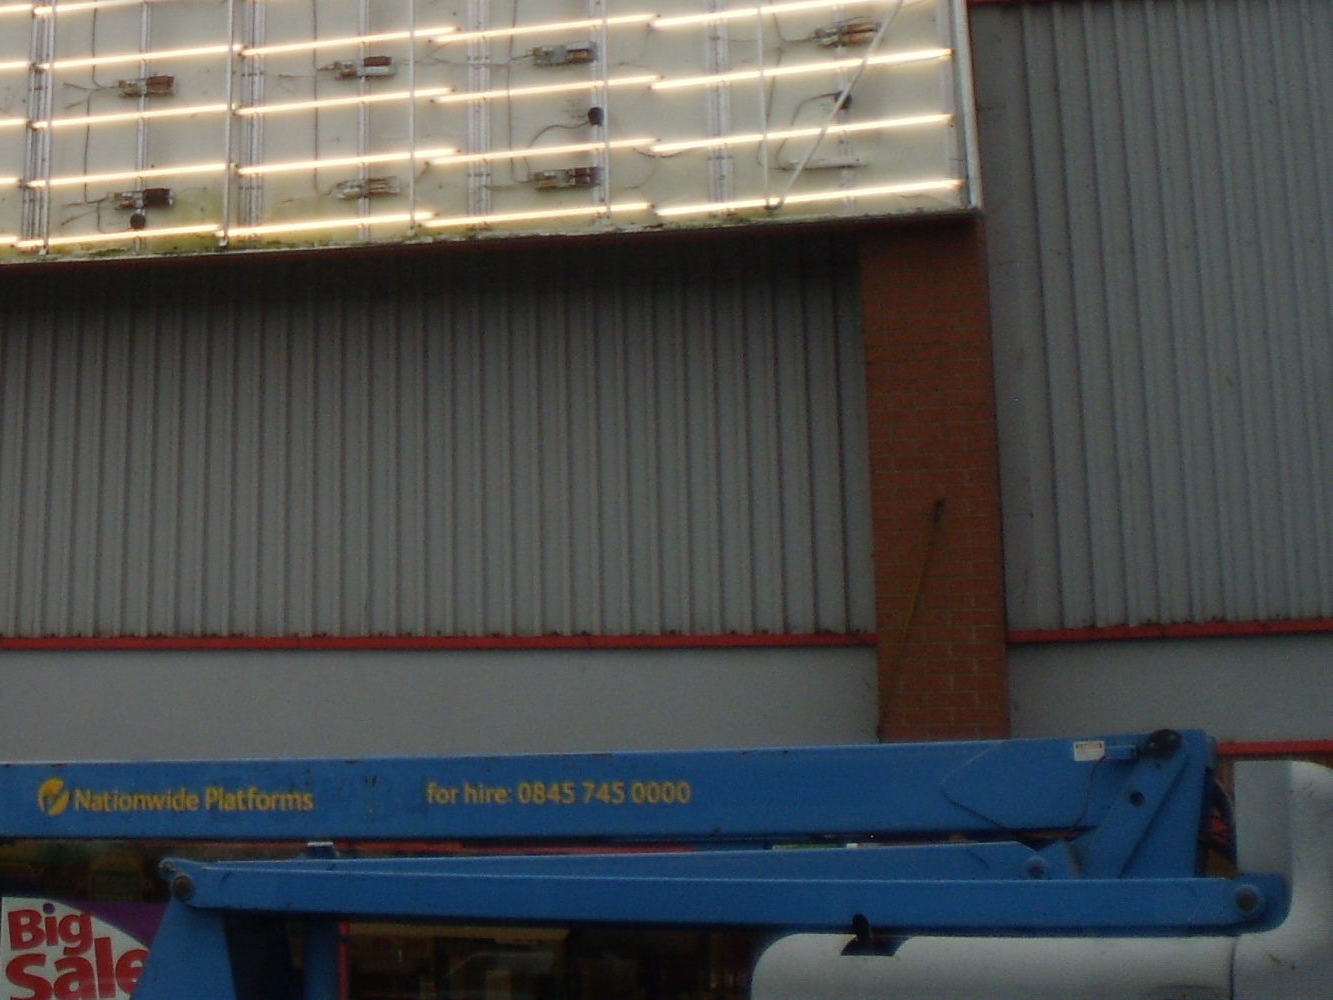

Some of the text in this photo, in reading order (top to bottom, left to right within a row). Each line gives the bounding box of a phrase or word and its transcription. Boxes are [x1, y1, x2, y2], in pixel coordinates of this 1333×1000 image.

[74, 785, 314, 812] Nationwide Platforms
[426, 781, 458, 804] for
[517, 782, 575, 805] 0845
[582, 781, 625, 804] 745
[631, 780, 692, 804] 0000
[7, 902, 94, 956] Big
[5, 936, 150, 1000] Sale
